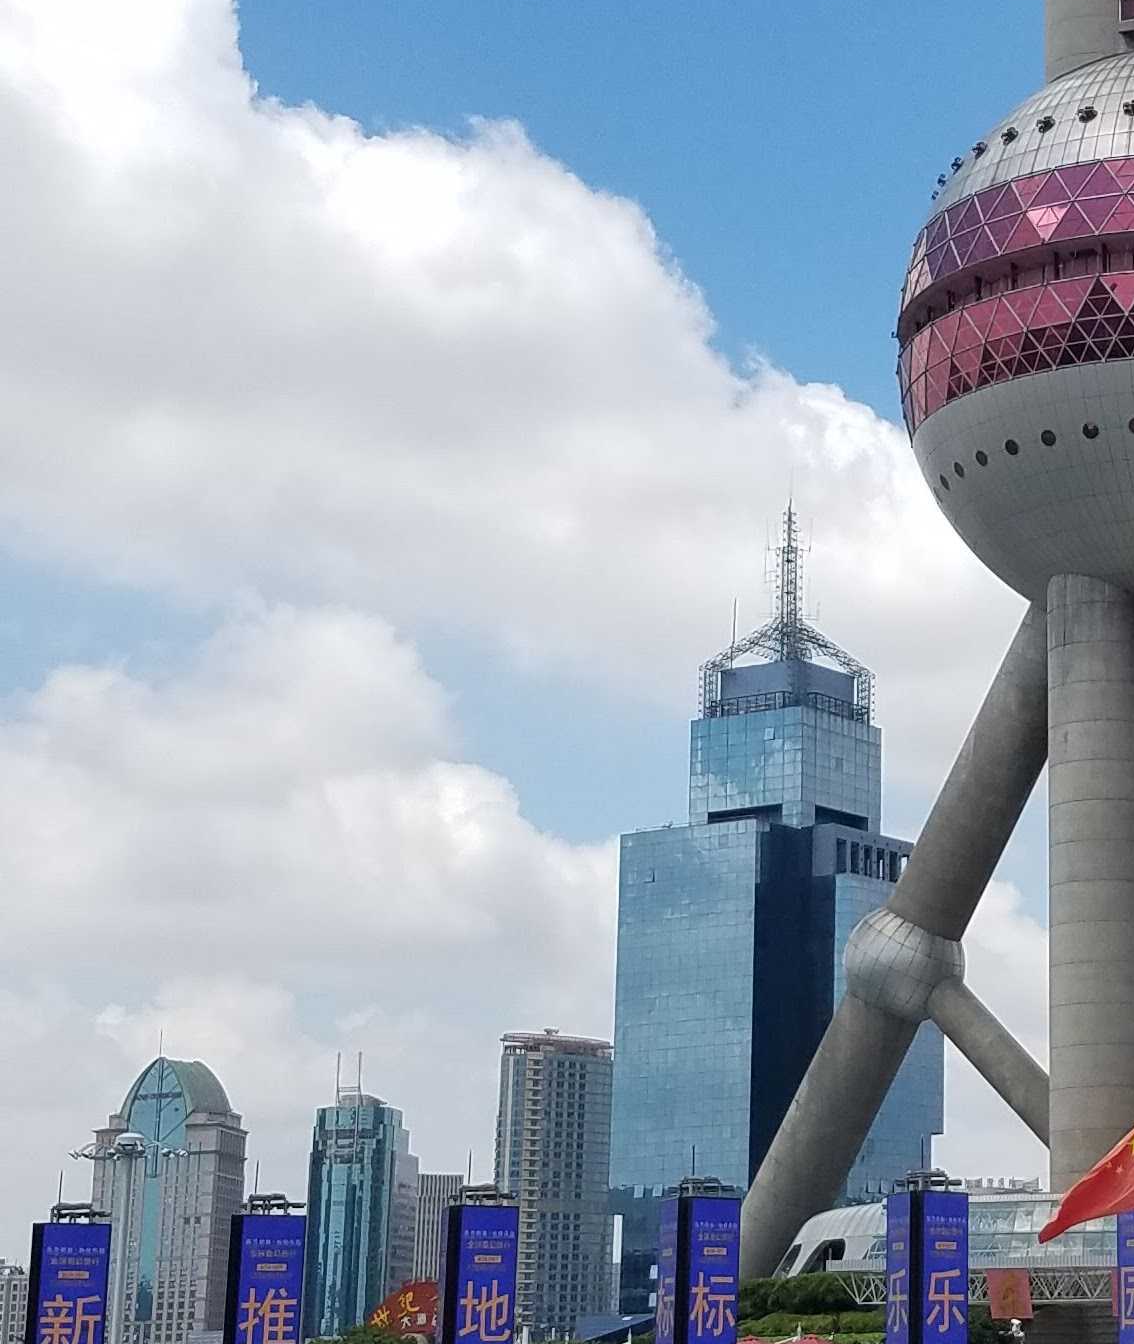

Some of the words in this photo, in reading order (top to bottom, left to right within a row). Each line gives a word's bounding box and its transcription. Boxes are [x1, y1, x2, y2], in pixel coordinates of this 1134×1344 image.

[458, 1279, 512, 1343] 地
[655, 1277, 675, 1339] 标
[689, 1271, 737, 1338] 标
[887, 1268, 908, 1334] 乐
[926, 1268, 967, 1334] 乐
